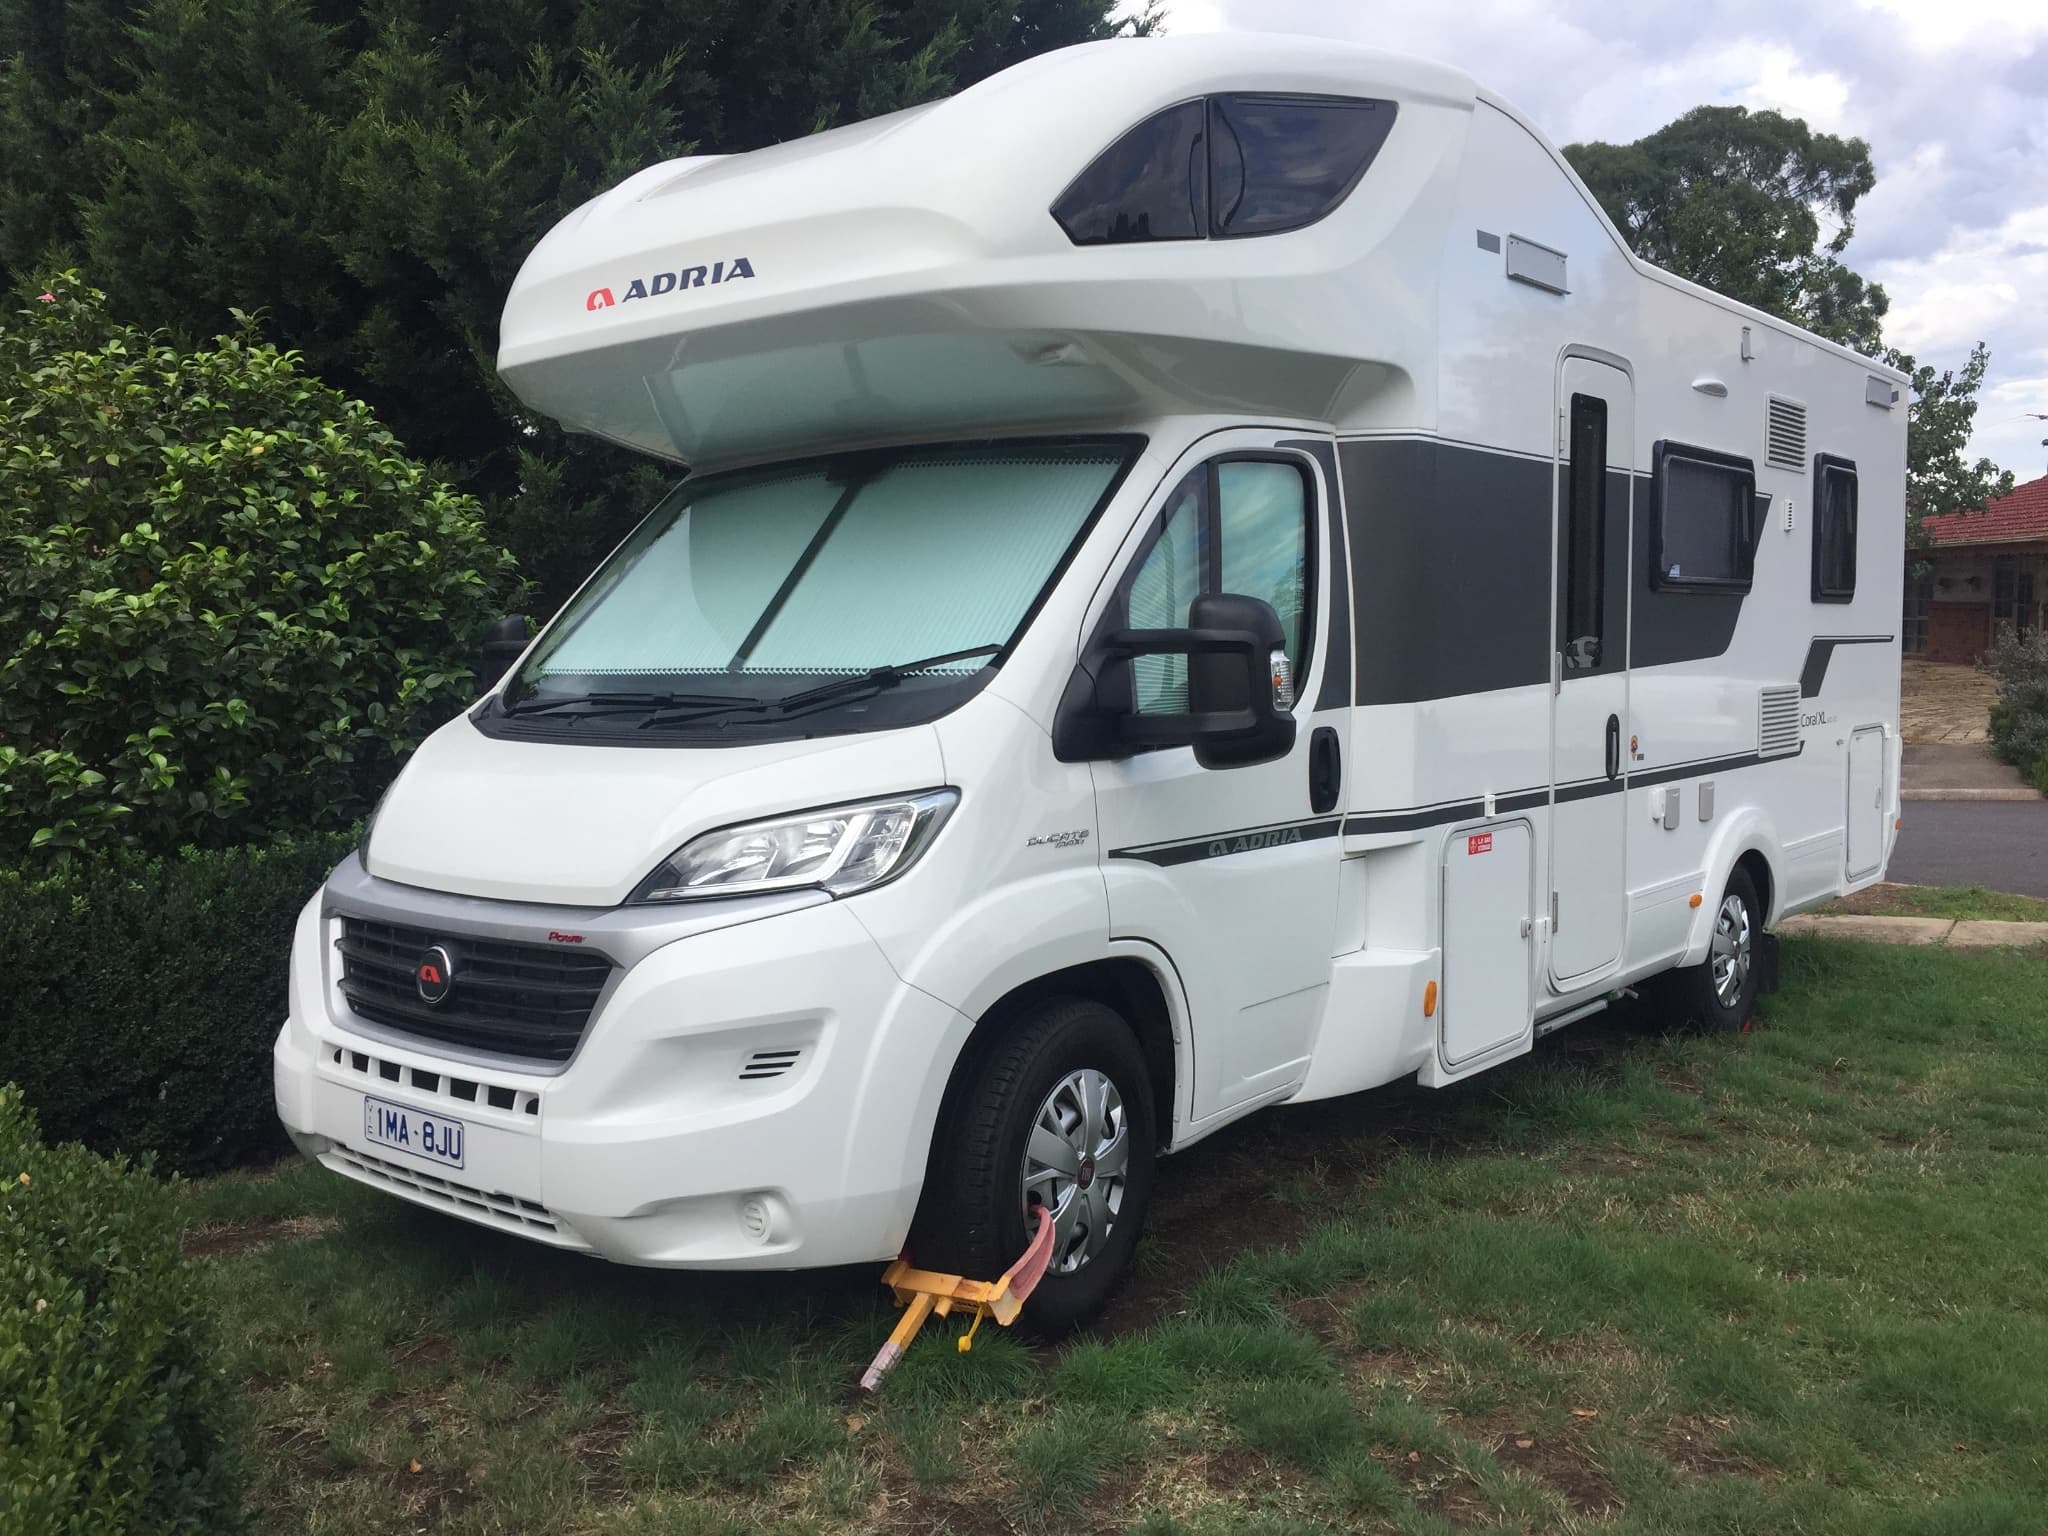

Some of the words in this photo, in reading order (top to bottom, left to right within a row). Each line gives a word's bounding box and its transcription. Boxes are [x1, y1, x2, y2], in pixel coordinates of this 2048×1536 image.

[621, 256, 756, 303] ADRIA
[1800, 711, 1818, 728] Coral
[1818, 711, 1827, 725] XL
[1231, 826, 1303, 853] ADRIA
